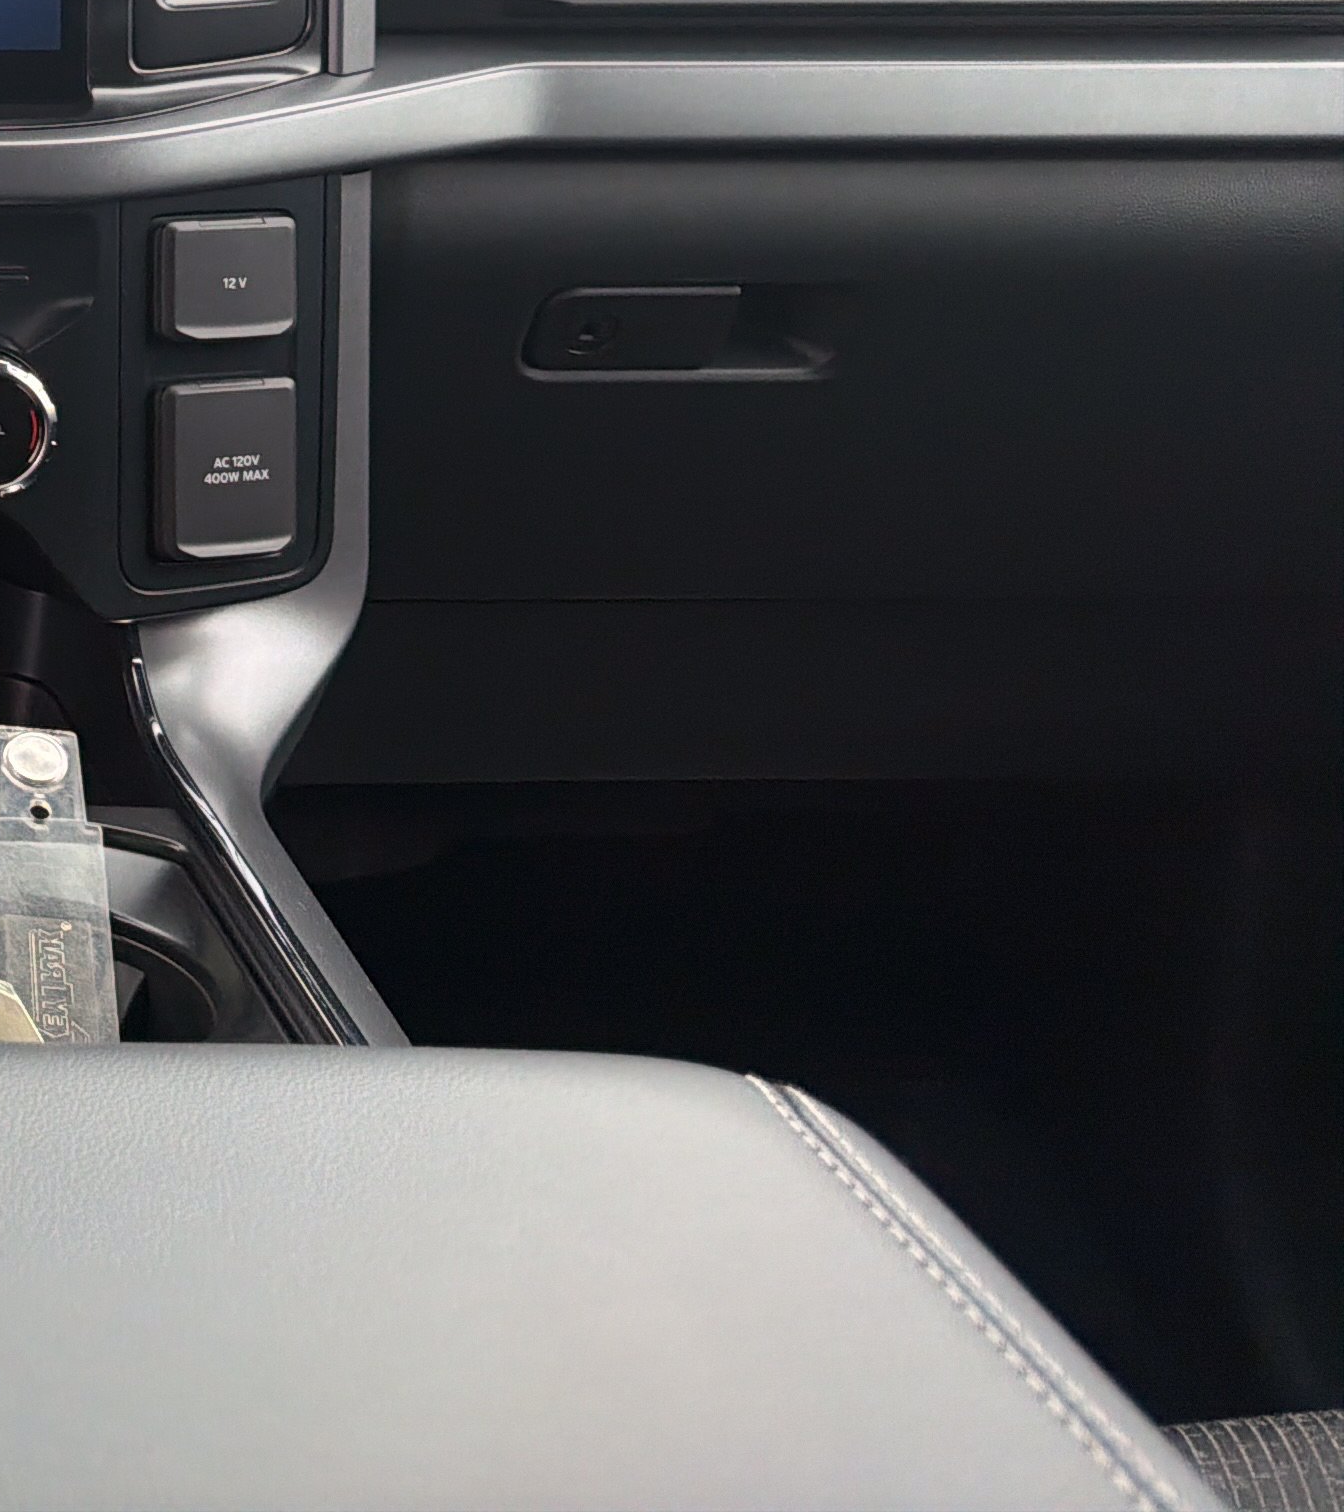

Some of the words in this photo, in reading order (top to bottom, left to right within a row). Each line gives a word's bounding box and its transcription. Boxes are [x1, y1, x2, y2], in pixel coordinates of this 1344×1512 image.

[222, 277, 236, 289] 12
[238, 277, 248, 289] V
[213, 456, 231, 469] AC
[232, 454, 261, 468] 120V
[203, 471, 239, 485] 400W
[242, 469, 270, 482] MAX
